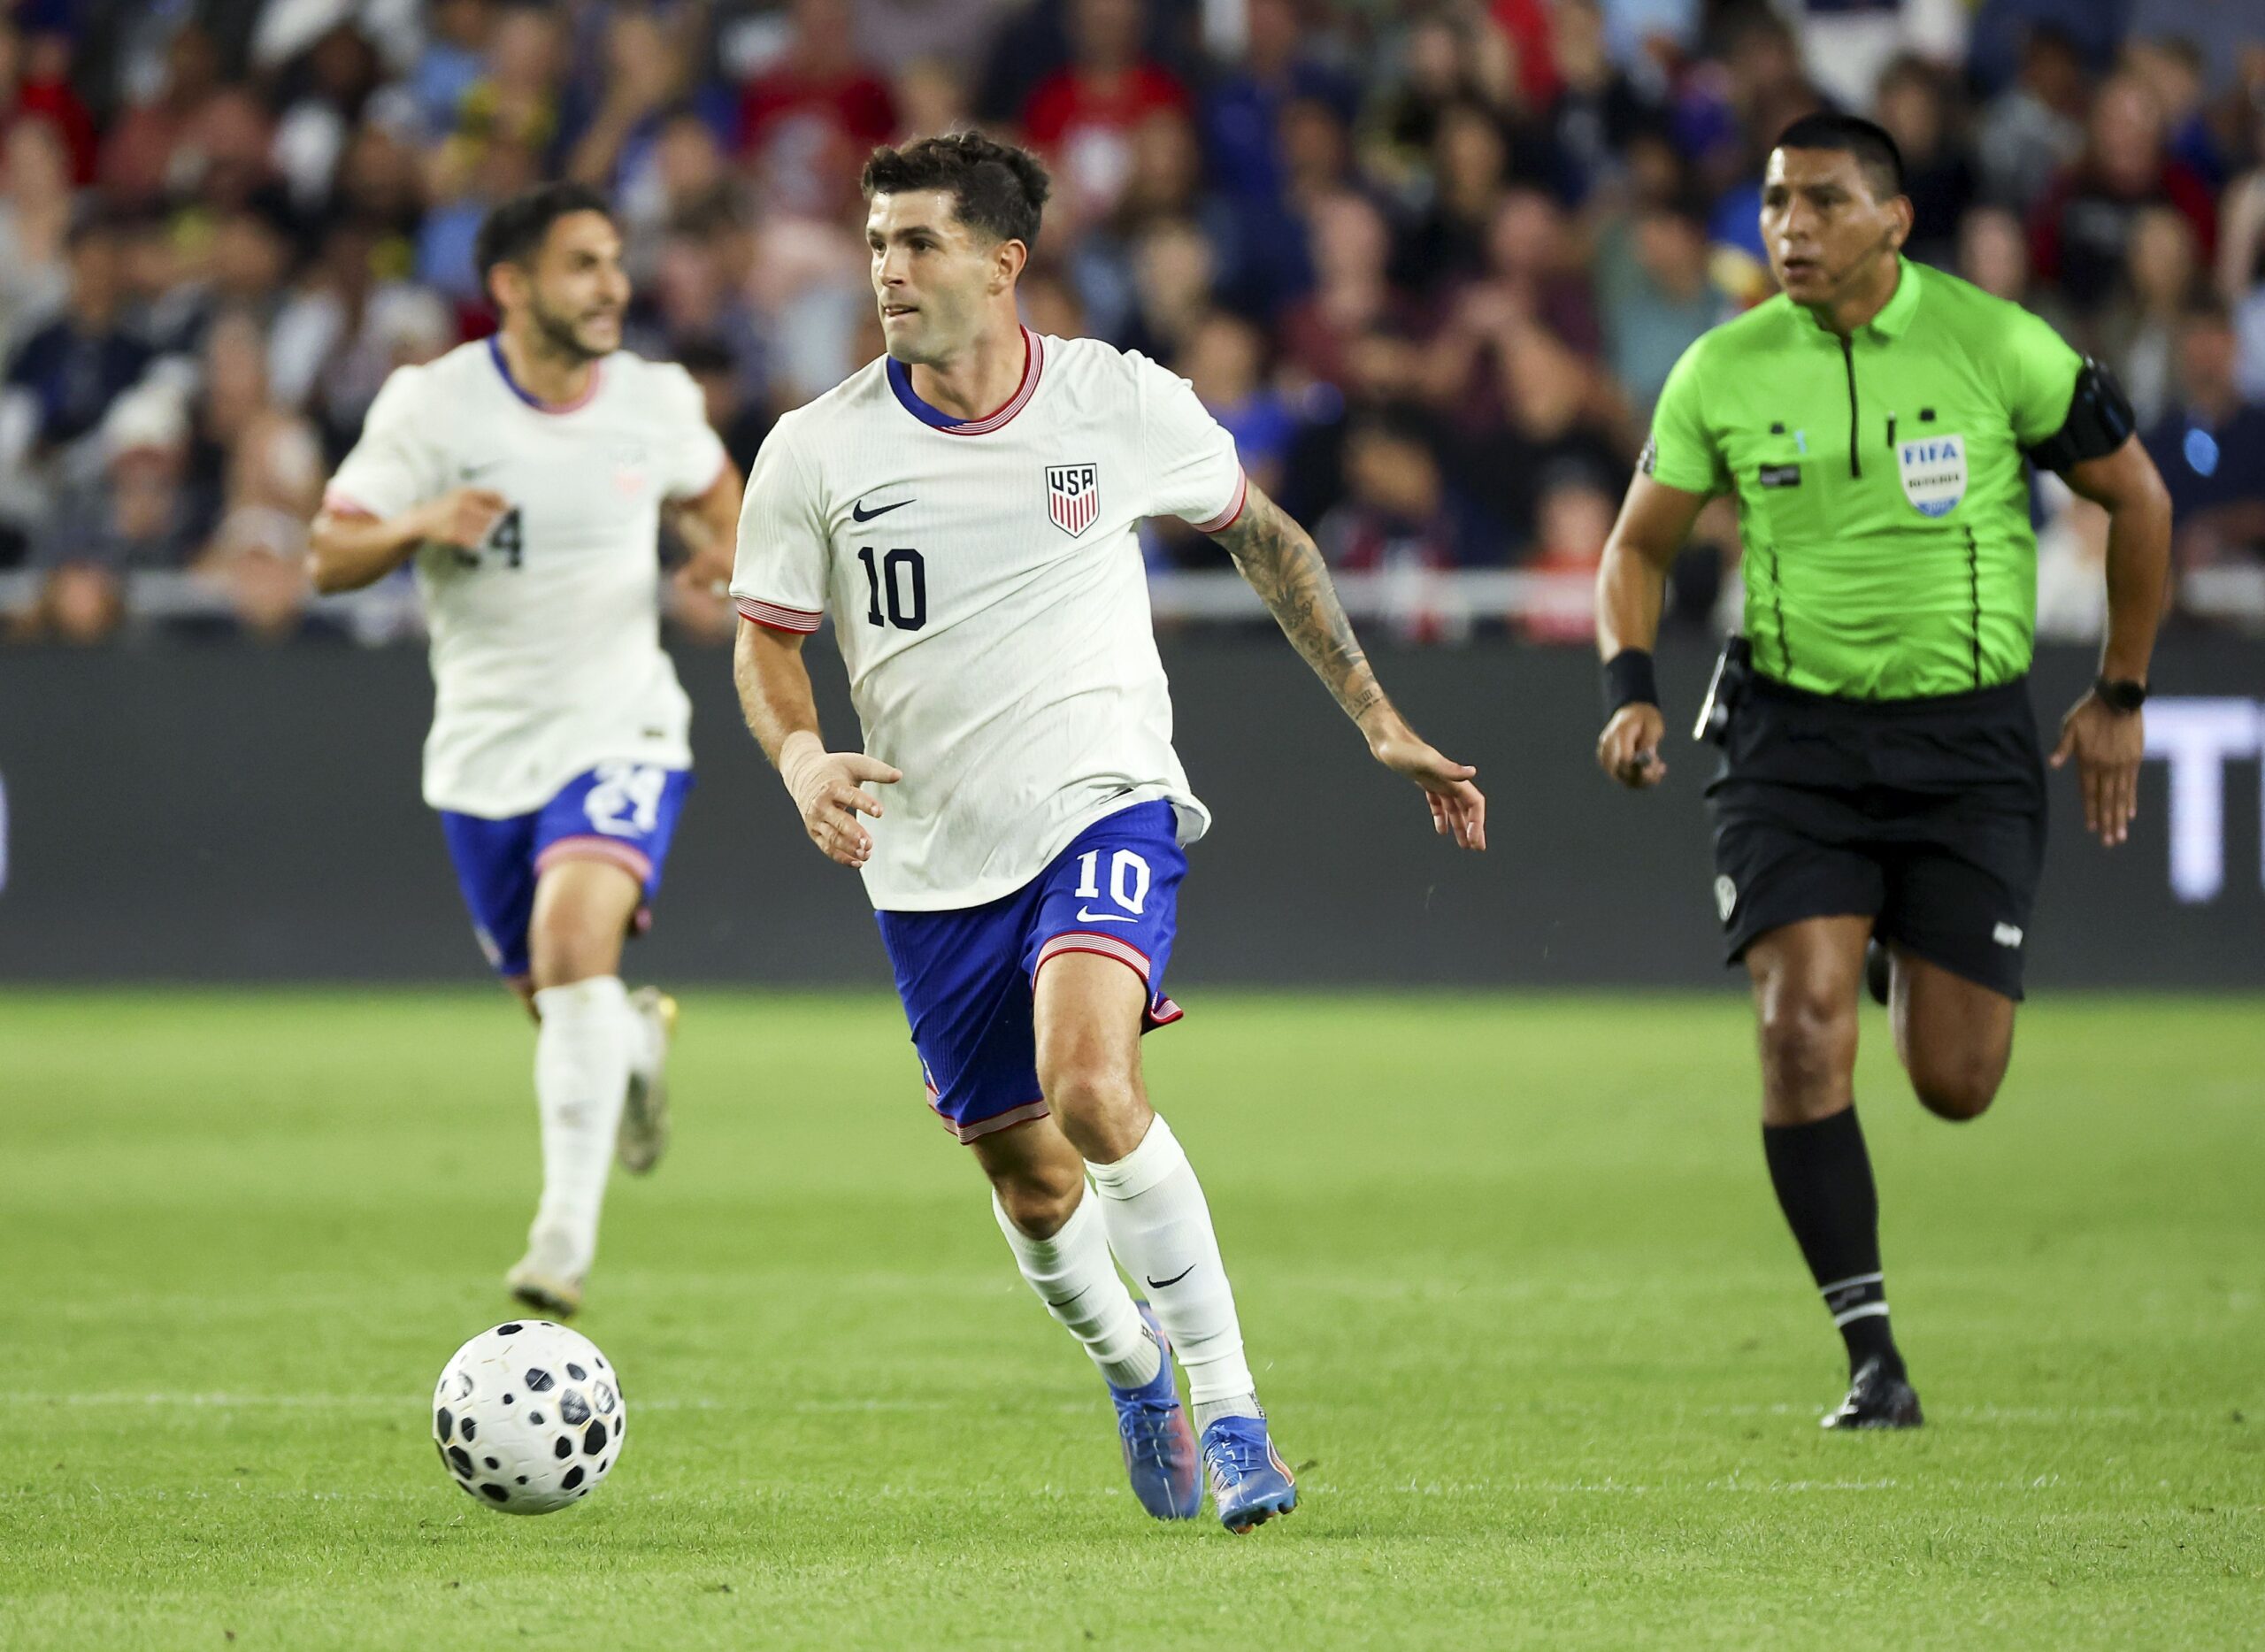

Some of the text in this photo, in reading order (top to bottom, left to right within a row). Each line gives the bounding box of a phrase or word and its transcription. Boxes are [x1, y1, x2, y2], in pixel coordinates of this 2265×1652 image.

[1904, 442, 1959, 465] FIFA
[1050, 468, 1094, 496] USA
[857, 546, 926, 631] 10
[1074, 848, 1151, 915] 10
